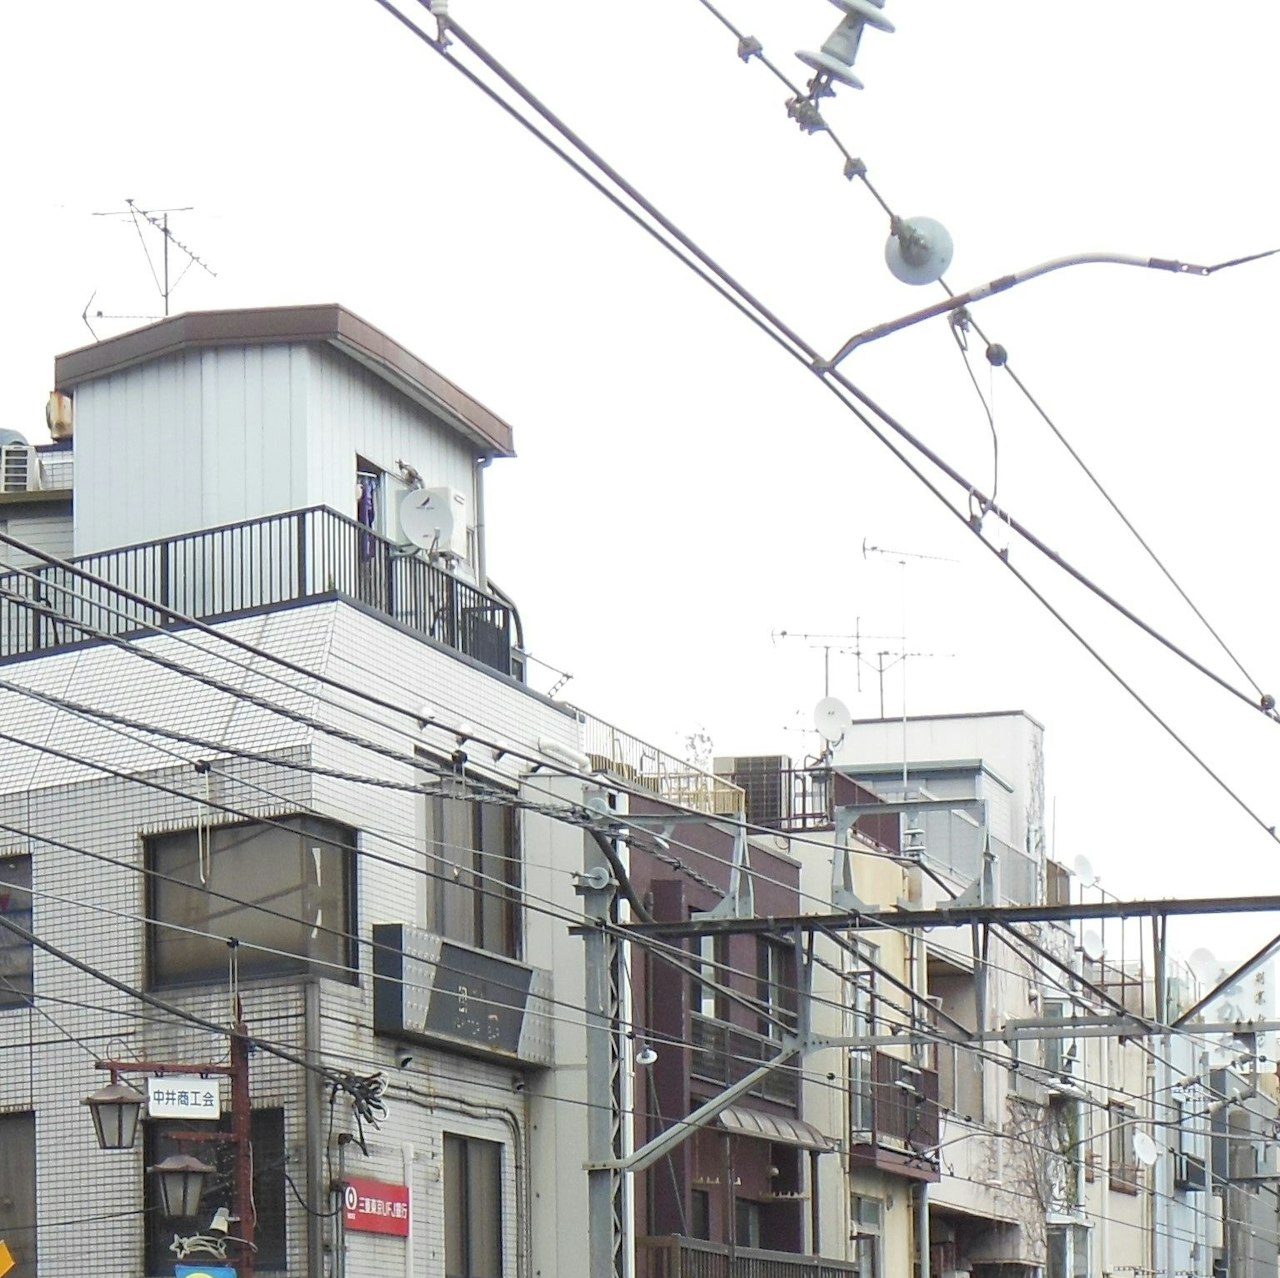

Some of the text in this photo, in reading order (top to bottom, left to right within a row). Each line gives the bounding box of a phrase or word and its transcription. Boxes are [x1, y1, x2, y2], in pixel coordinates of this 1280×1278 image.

[154, 1090, 214, 1107] 中井商工会
